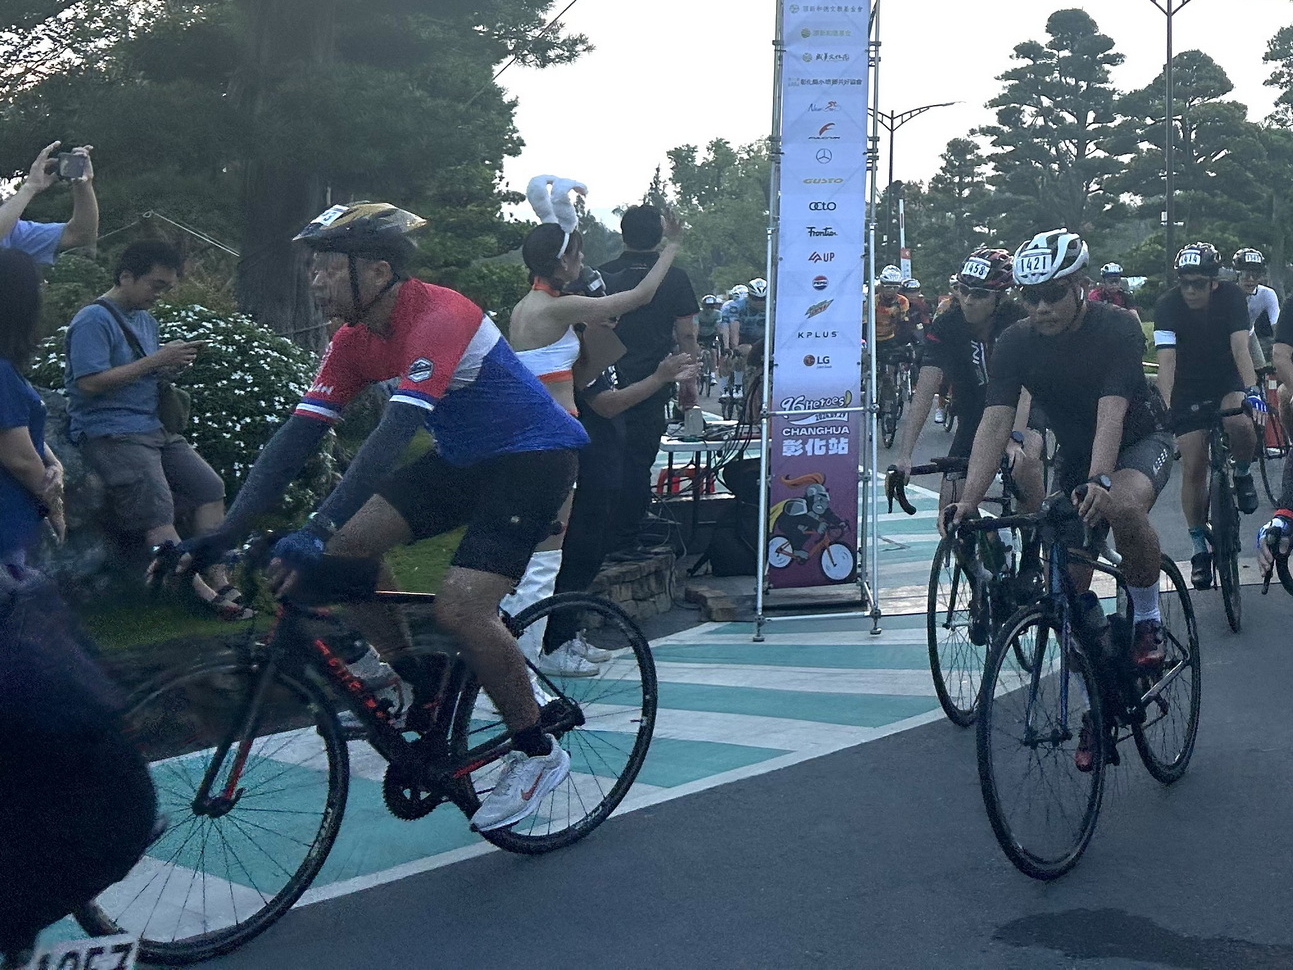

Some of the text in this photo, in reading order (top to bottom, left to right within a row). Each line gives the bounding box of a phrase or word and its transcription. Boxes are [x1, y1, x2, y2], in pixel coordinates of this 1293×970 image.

[1020, 256, 1047, 273] 1421
[816, 356, 830, 364] LG
[782, 426, 850, 436] CHANGHUA
[782, 437, 849, 457] 彰化站
